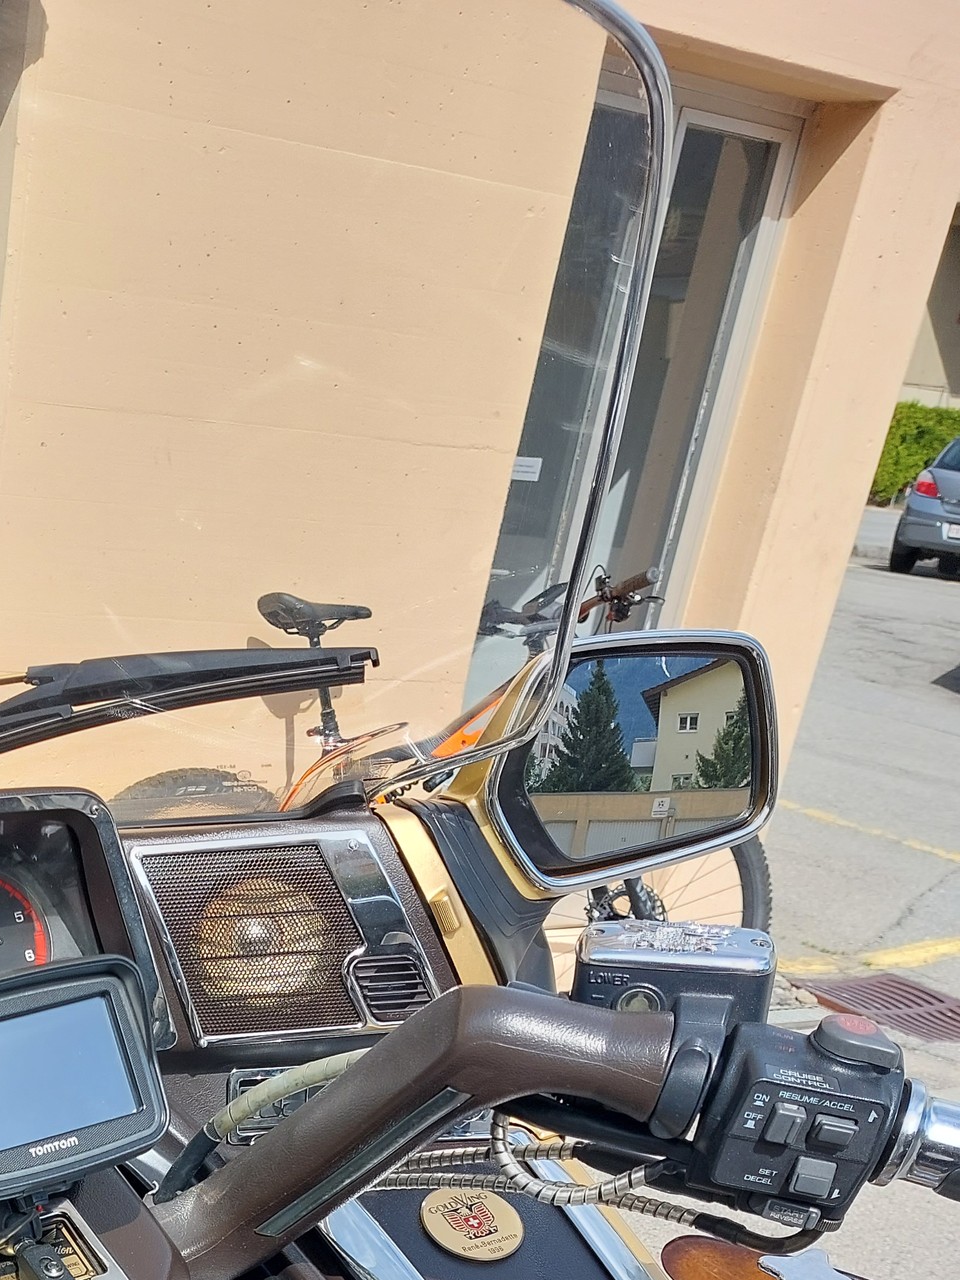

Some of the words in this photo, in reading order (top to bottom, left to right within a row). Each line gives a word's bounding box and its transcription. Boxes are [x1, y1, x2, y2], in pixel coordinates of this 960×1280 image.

[14, 911, 24, 923] 5
[25, 950, 35, 962] 6
[588, 970, 630, 986] LOWER
[773, 1073, 834, 1089] CONTROL
[779, 1069, 824, 1081] CRUISE
[753, 1093, 770, 1103] ON
[779, 1091, 855, 1112] RESUME/ACCEL
[744, 1111, 764, 1121] OFF
[759, 1168, 778, 1177] SET
[744, 1174, 773, 1186] DECEL
